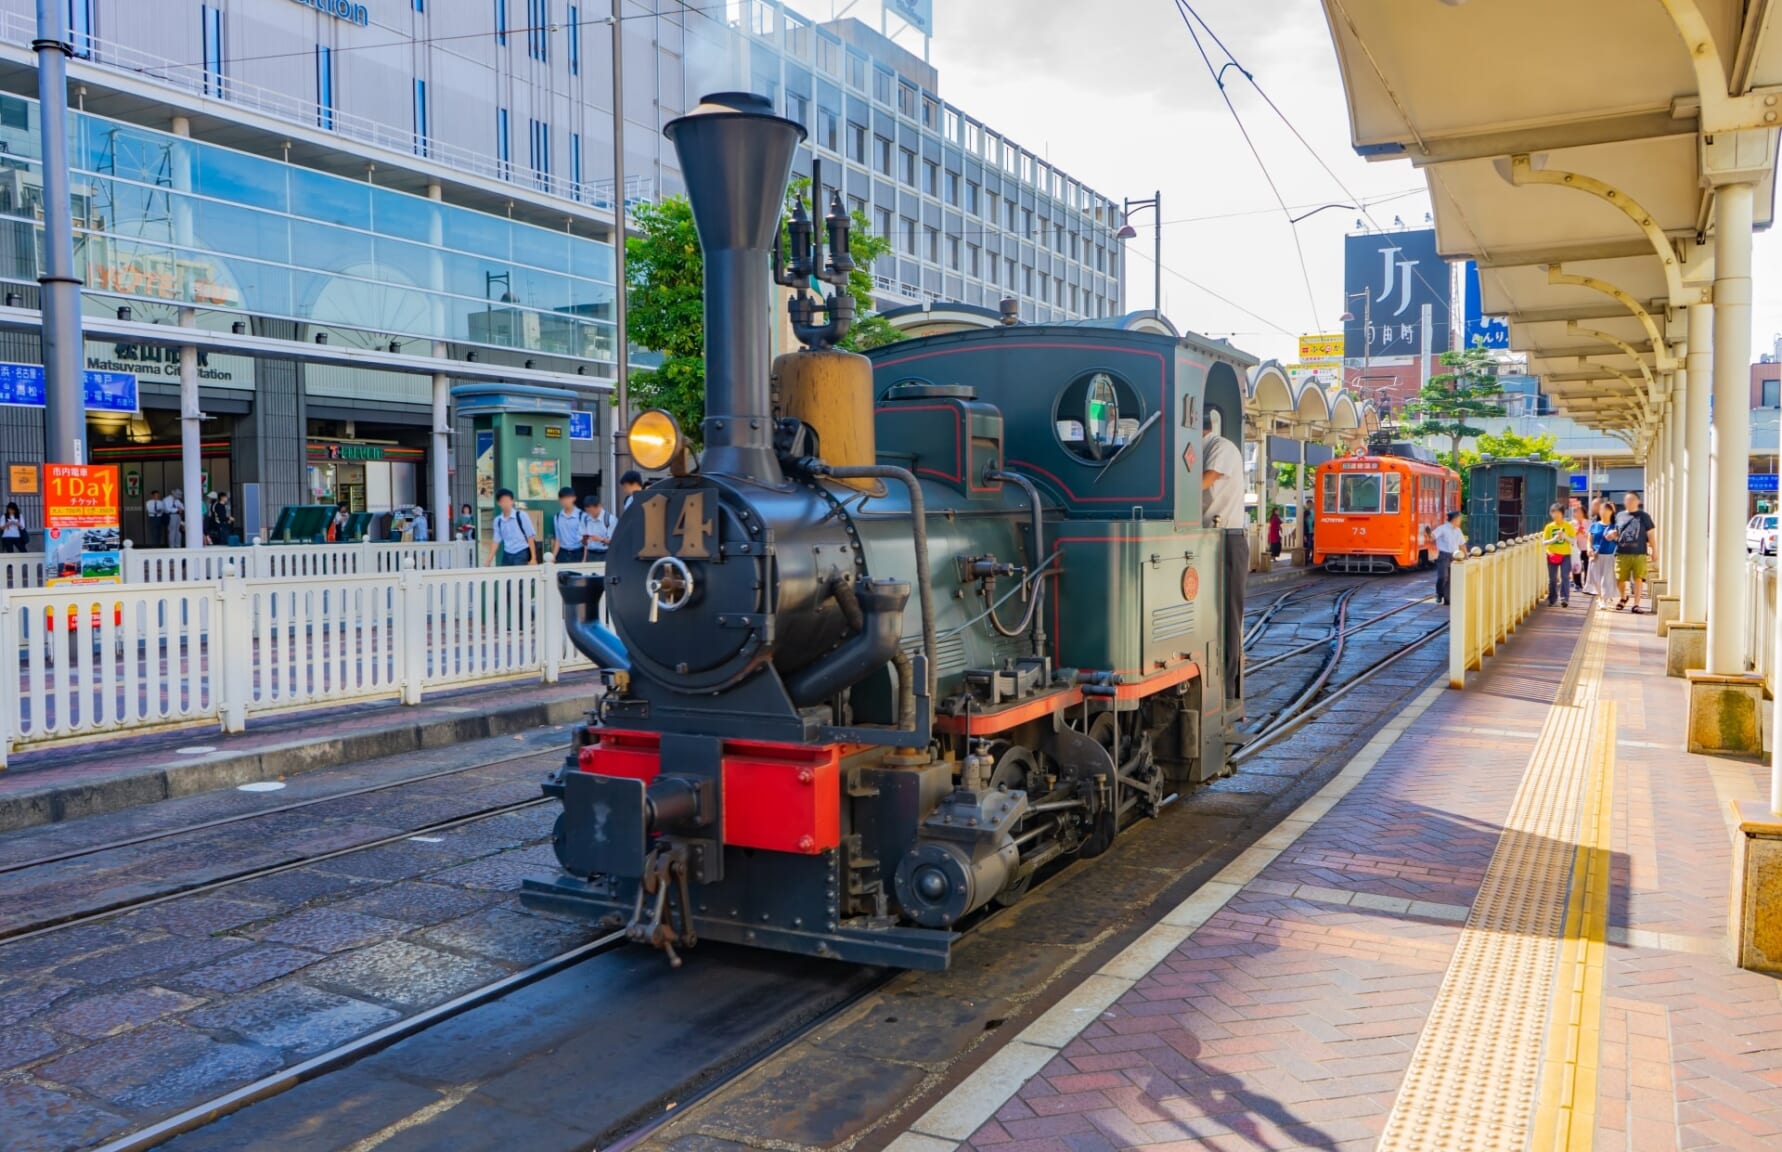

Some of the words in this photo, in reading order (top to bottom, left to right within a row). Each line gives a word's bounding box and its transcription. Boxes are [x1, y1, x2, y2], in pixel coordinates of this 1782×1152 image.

[87, 358, 160, 374] Matsuyama
[164, 364, 181, 376] Cit
[197, 368, 232, 380] tation
[638, 491, 713, 557] 14
[1352, 527, 1366, 535] 73
